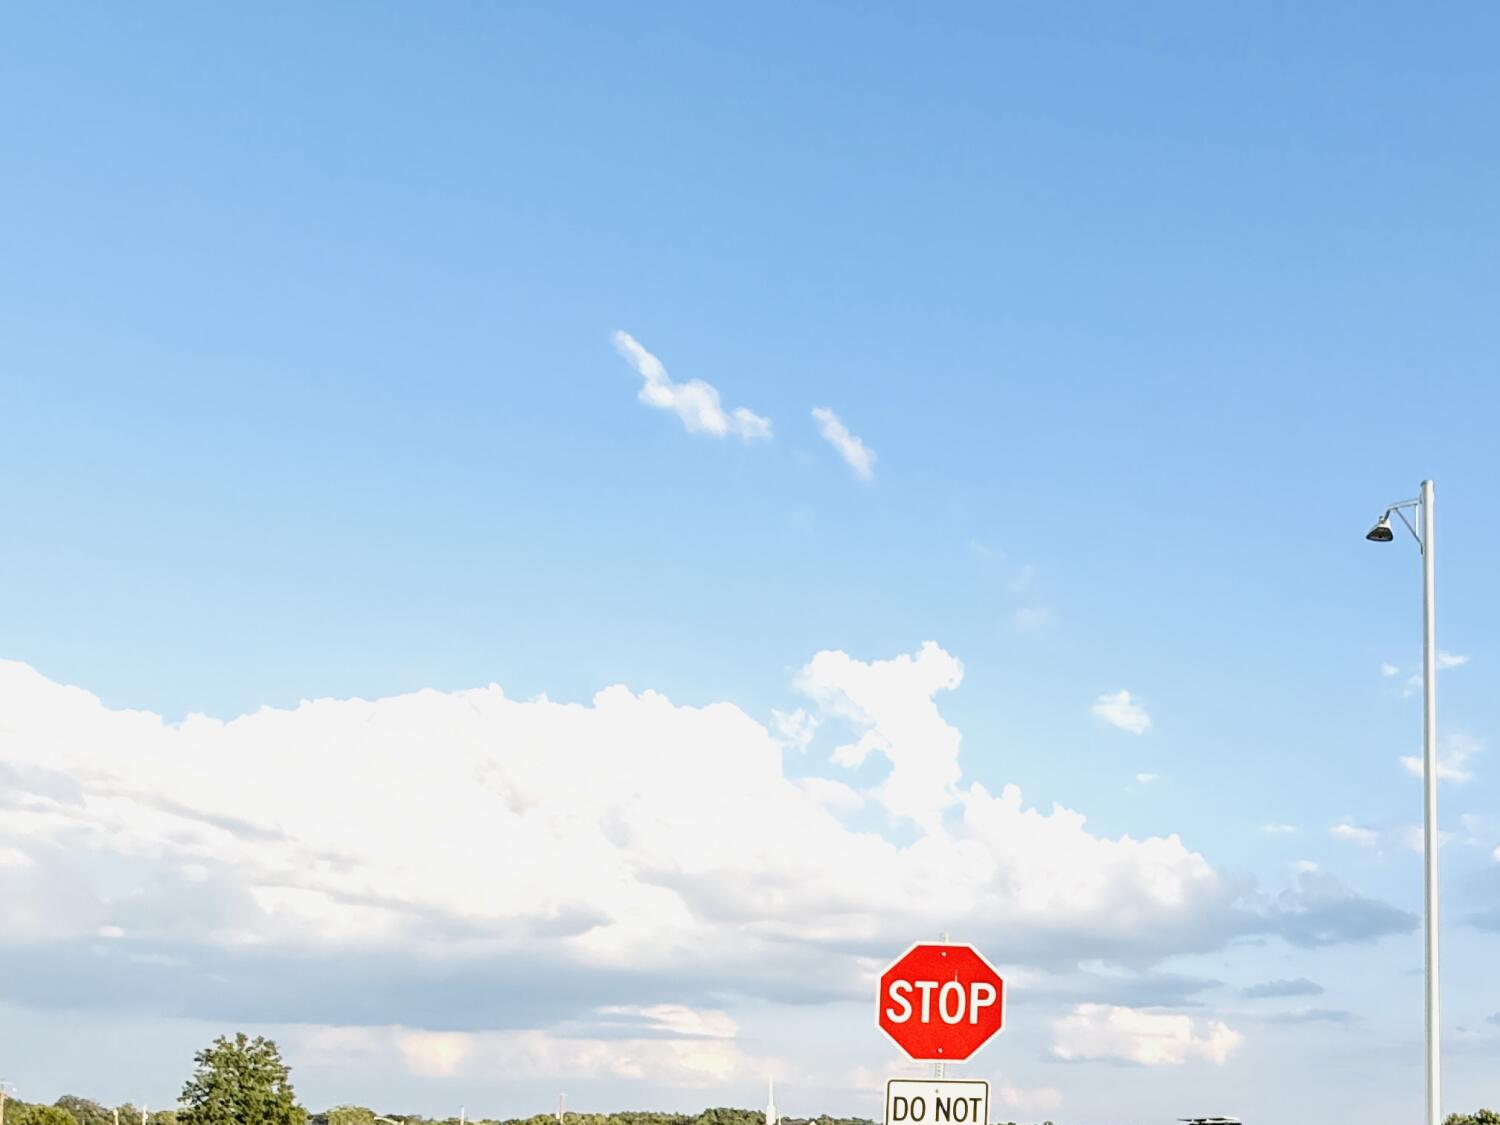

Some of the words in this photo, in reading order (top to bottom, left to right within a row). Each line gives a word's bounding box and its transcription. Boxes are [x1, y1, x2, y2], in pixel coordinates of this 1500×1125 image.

[886, 979, 997, 1024] STOP
[892, 1096, 926, 1122] DO
[935, 1096, 982, 1123] NOT
